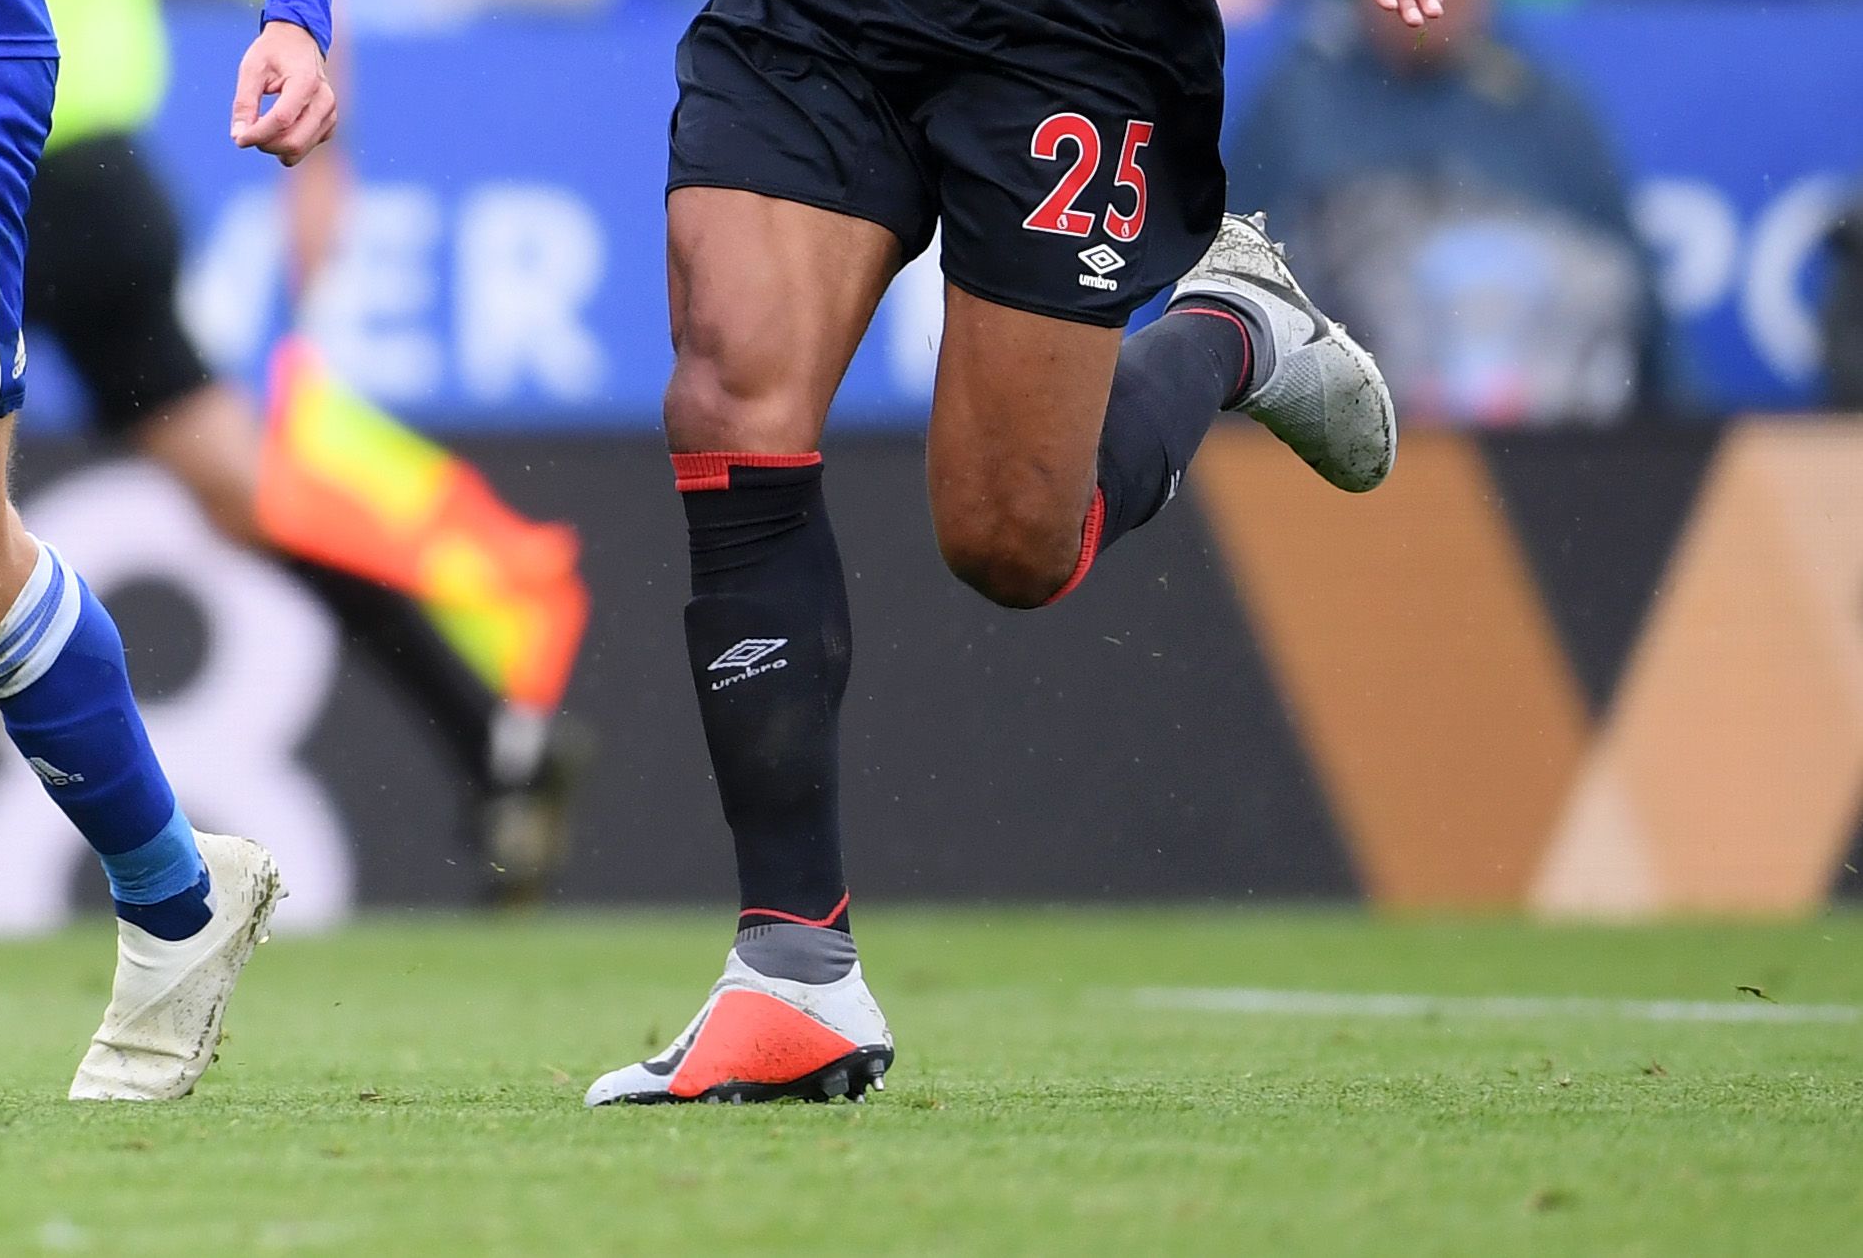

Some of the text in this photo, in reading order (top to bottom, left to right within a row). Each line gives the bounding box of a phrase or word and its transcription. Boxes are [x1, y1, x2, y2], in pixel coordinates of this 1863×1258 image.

[1022, 111, 1155, 243] 25
[1078, 272, 1118, 291] umbro
[711, 658, 789, 691] umbro
